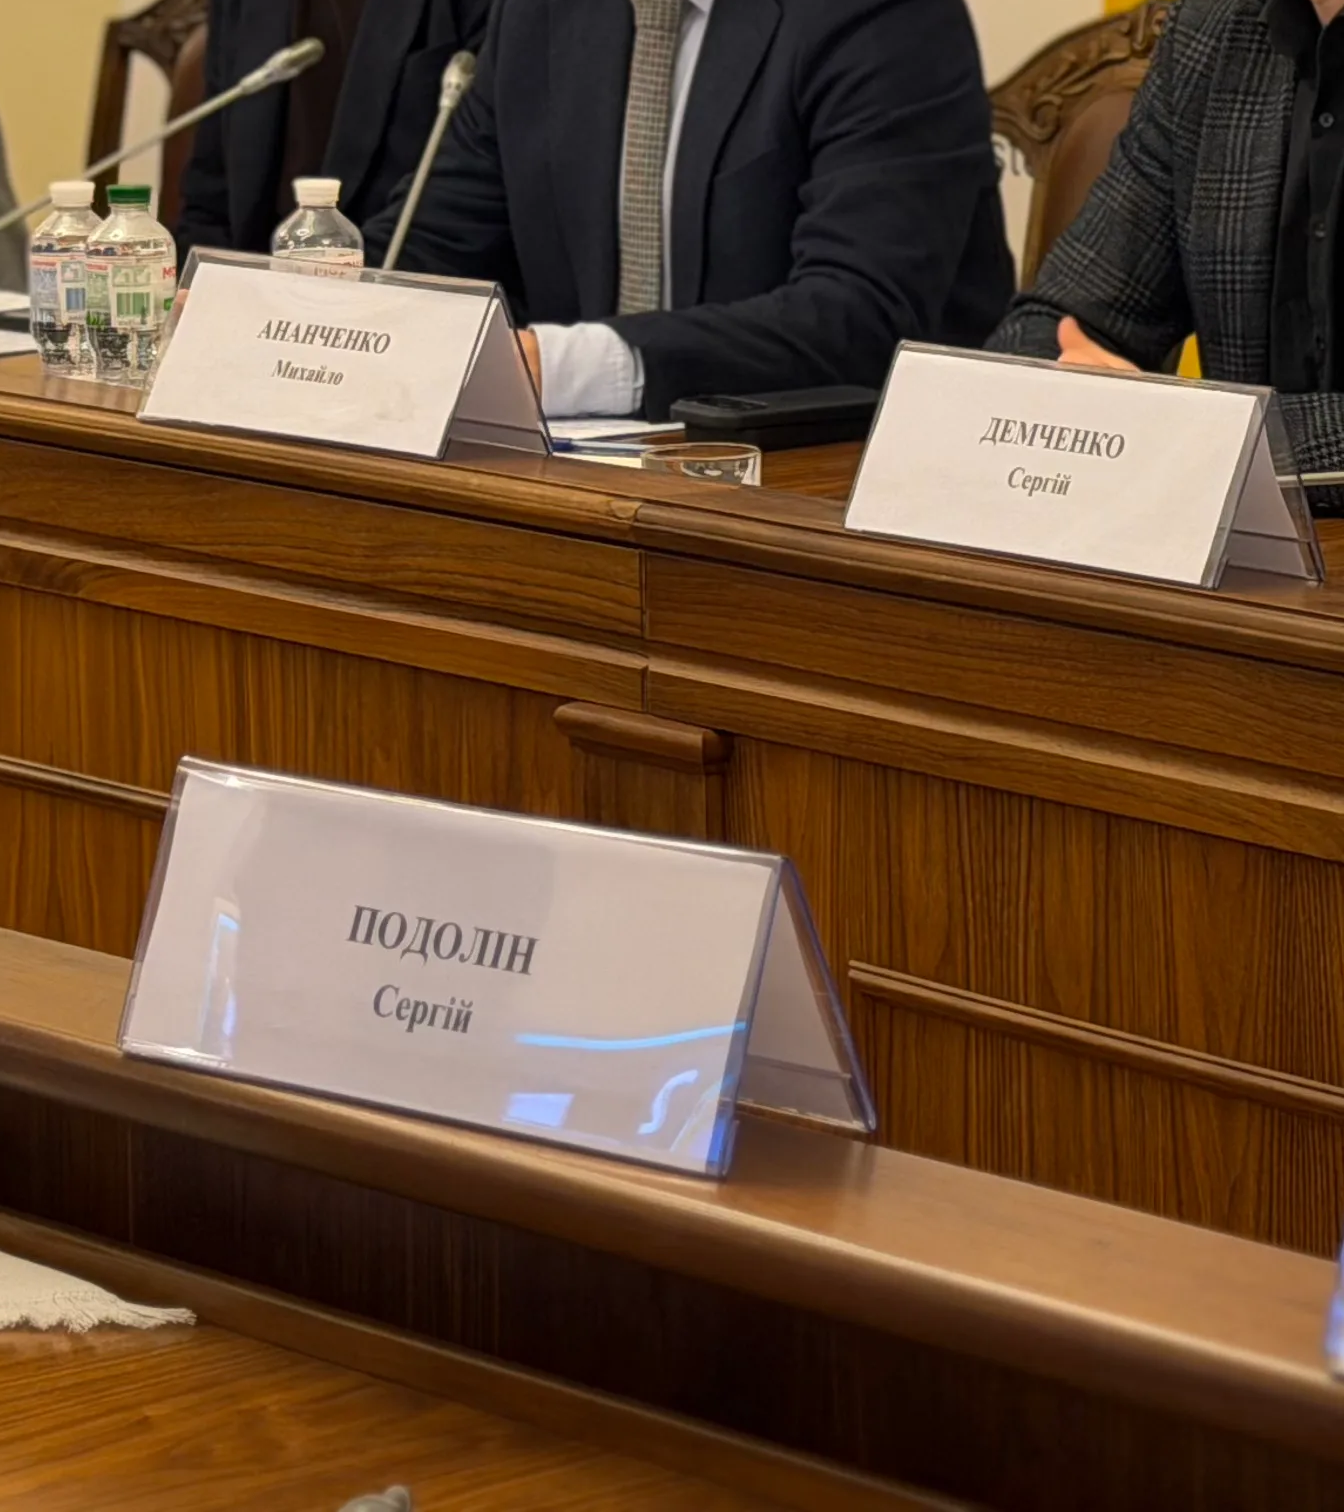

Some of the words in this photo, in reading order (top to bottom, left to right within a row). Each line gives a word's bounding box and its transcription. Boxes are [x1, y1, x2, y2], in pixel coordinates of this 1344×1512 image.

[257, 319, 392, 355] АНАНЧЕНКО
[271, 359, 344, 386] Михайло
[979, 417, 1125, 459] ДЕМЧЕНКО
[1007, 466, 1072, 497] Сергій
[346, 905, 539, 975] ПОДОЛІН
[373, 983, 474, 1033] Сергій
